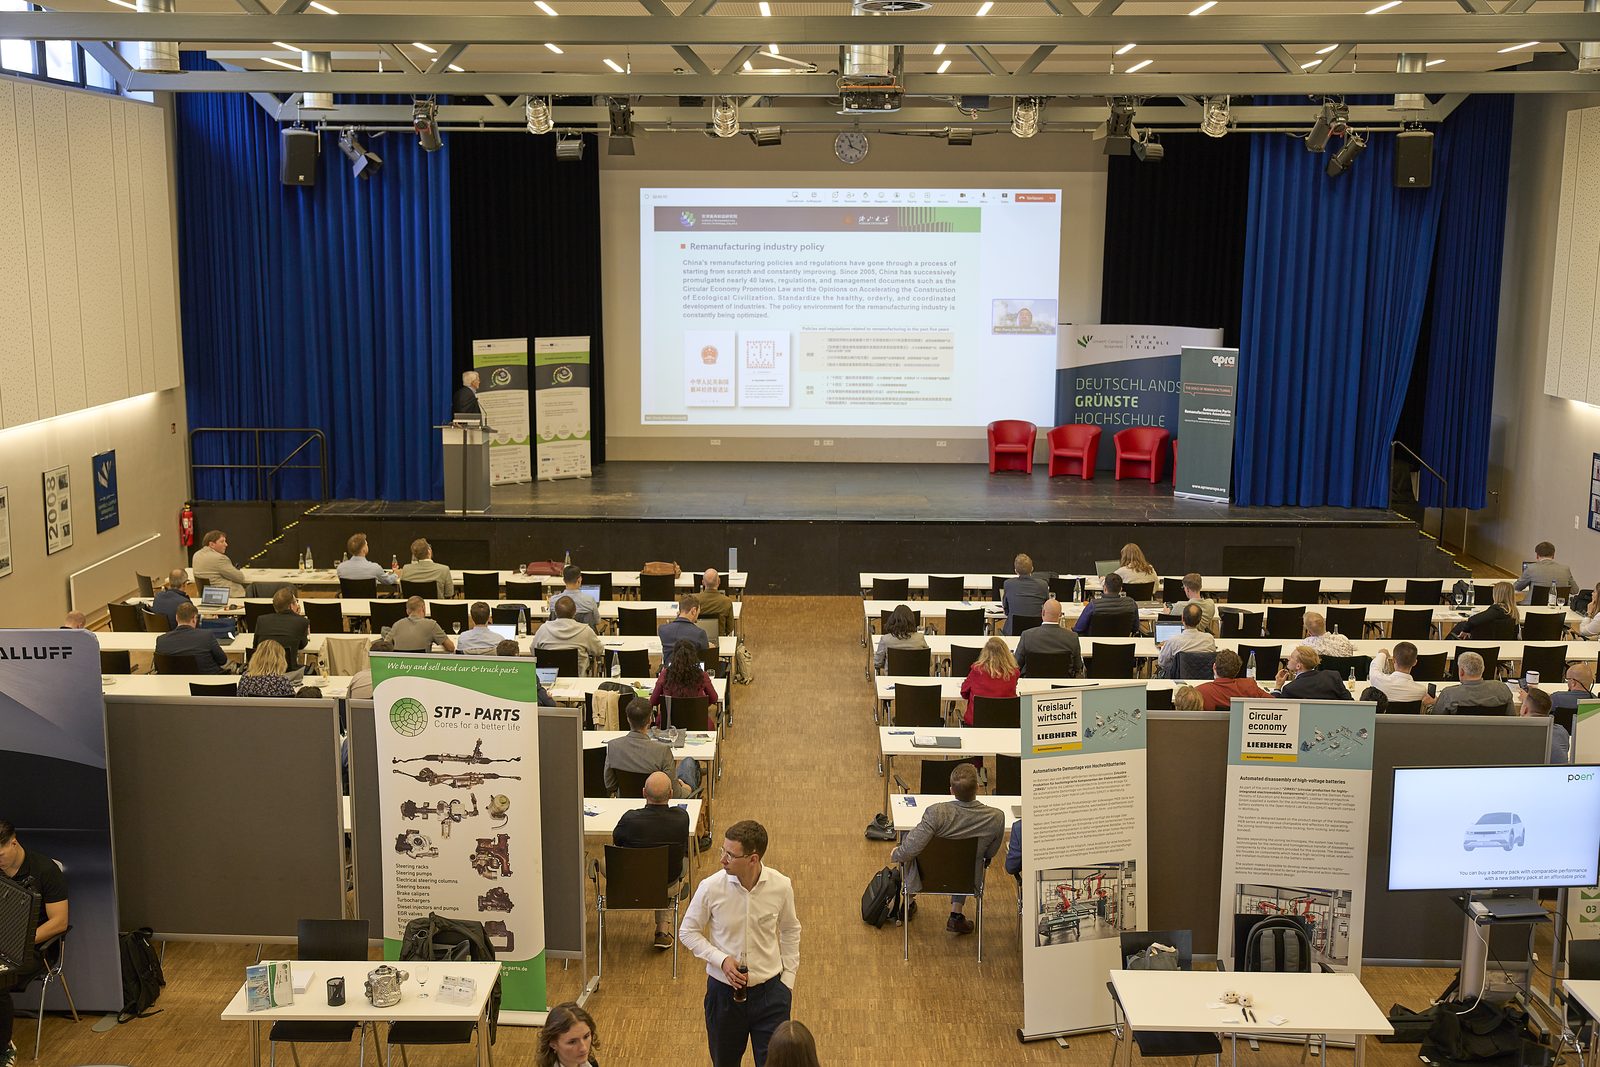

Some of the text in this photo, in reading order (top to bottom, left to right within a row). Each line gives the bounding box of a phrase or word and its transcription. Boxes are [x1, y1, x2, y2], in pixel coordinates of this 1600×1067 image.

[690, 242, 824, 252] Remanufacturing industry policy
[709, 259, 765, 267] remanufacturing
[766, 259, 792, 268] policies
[809, 259, 847, 268] regulations
[885, 260, 912, 268] through
[682, 268, 708, 276] starting
[766, 268, 801, 276] constantly
[913, 268, 955, 276] successively
[682, 276, 725, 285] promulgated
[726, 276, 747, 285] nearly
[833, 277, 876, 285] management
[710, 285, 740, 294] Economy
[818, 286, 847, 294] Opinions
[859, 286, 899, 294] Accelerating
[692, 294, 730, 302] Ecological
[682, 311, 715, 320] constantly
[717, 311, 735, 320] being
[1212, 356, 1235, 367] apra
[1076, 378, 1181, 394] DEUTSCHLANDS
[1075, 394, 1138, 408] GRÜNSTE
[1074, 413, 1164, 426] HOCHSCHULE
[47, 476, 58, 540] 2008
[0, 647, 72, 659] ALLUFF
[399, 662, 412, 672] buy
[498, 666, 518, 675] parts
[1037, 701, 1073, 712] Kreislauf-
[434, 706, 461, 719] STP
[474, 708, 520, 721] PARTS
[1037, 710, 1076, 722] wirtschaft
[1248, 711, 1282, 721] Circular
[434, 720, 458, 729] Cores
[481, 722, 505, 731] better
[1248, 723, 1287, 733] economy
[1037, 732, 1077, 740] LIEBHERR
[1062, 764, 1084, 772] Demontage
[1091, 760, 1125, 769] Hochvoltbatterien
[1568, 774, 1592, 783] poen
